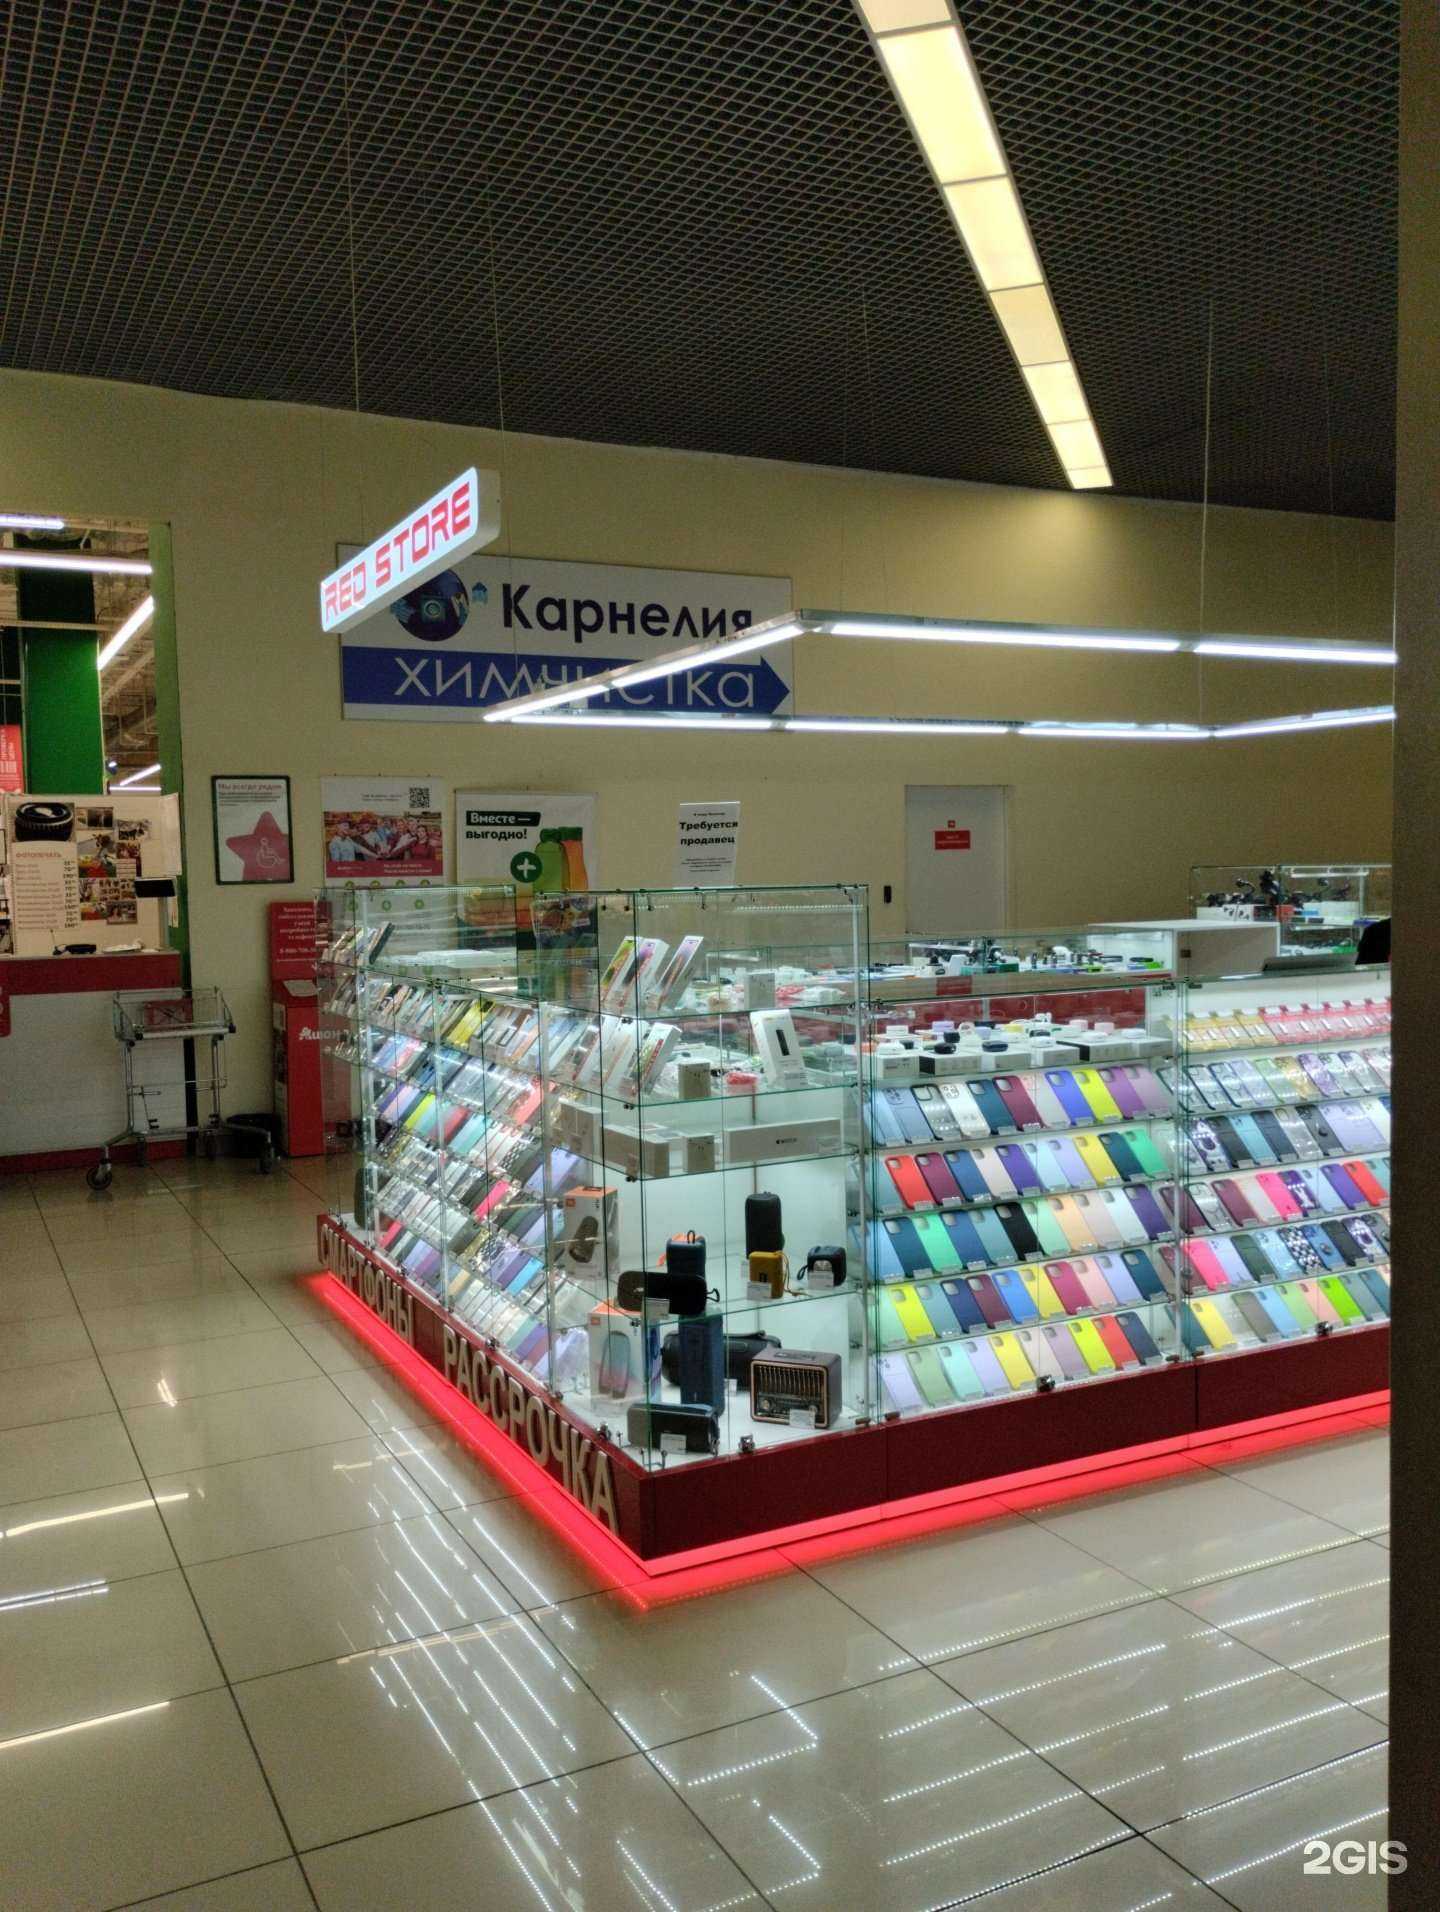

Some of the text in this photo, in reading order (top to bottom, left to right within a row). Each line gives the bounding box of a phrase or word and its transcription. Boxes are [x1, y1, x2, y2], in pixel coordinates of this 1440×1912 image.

[325, 482, 471, 623] RED STORE
[502, 583, 752, 643] Карнелия
[470, 812, 517, 825] Вместе
[679, 821, 738, 831] Требуется
[465, 829, 528, 842] выгодно!
[680, 836, 735, 846] продавец
[443, 1322, 619, 1535] РАССРОЧКА
